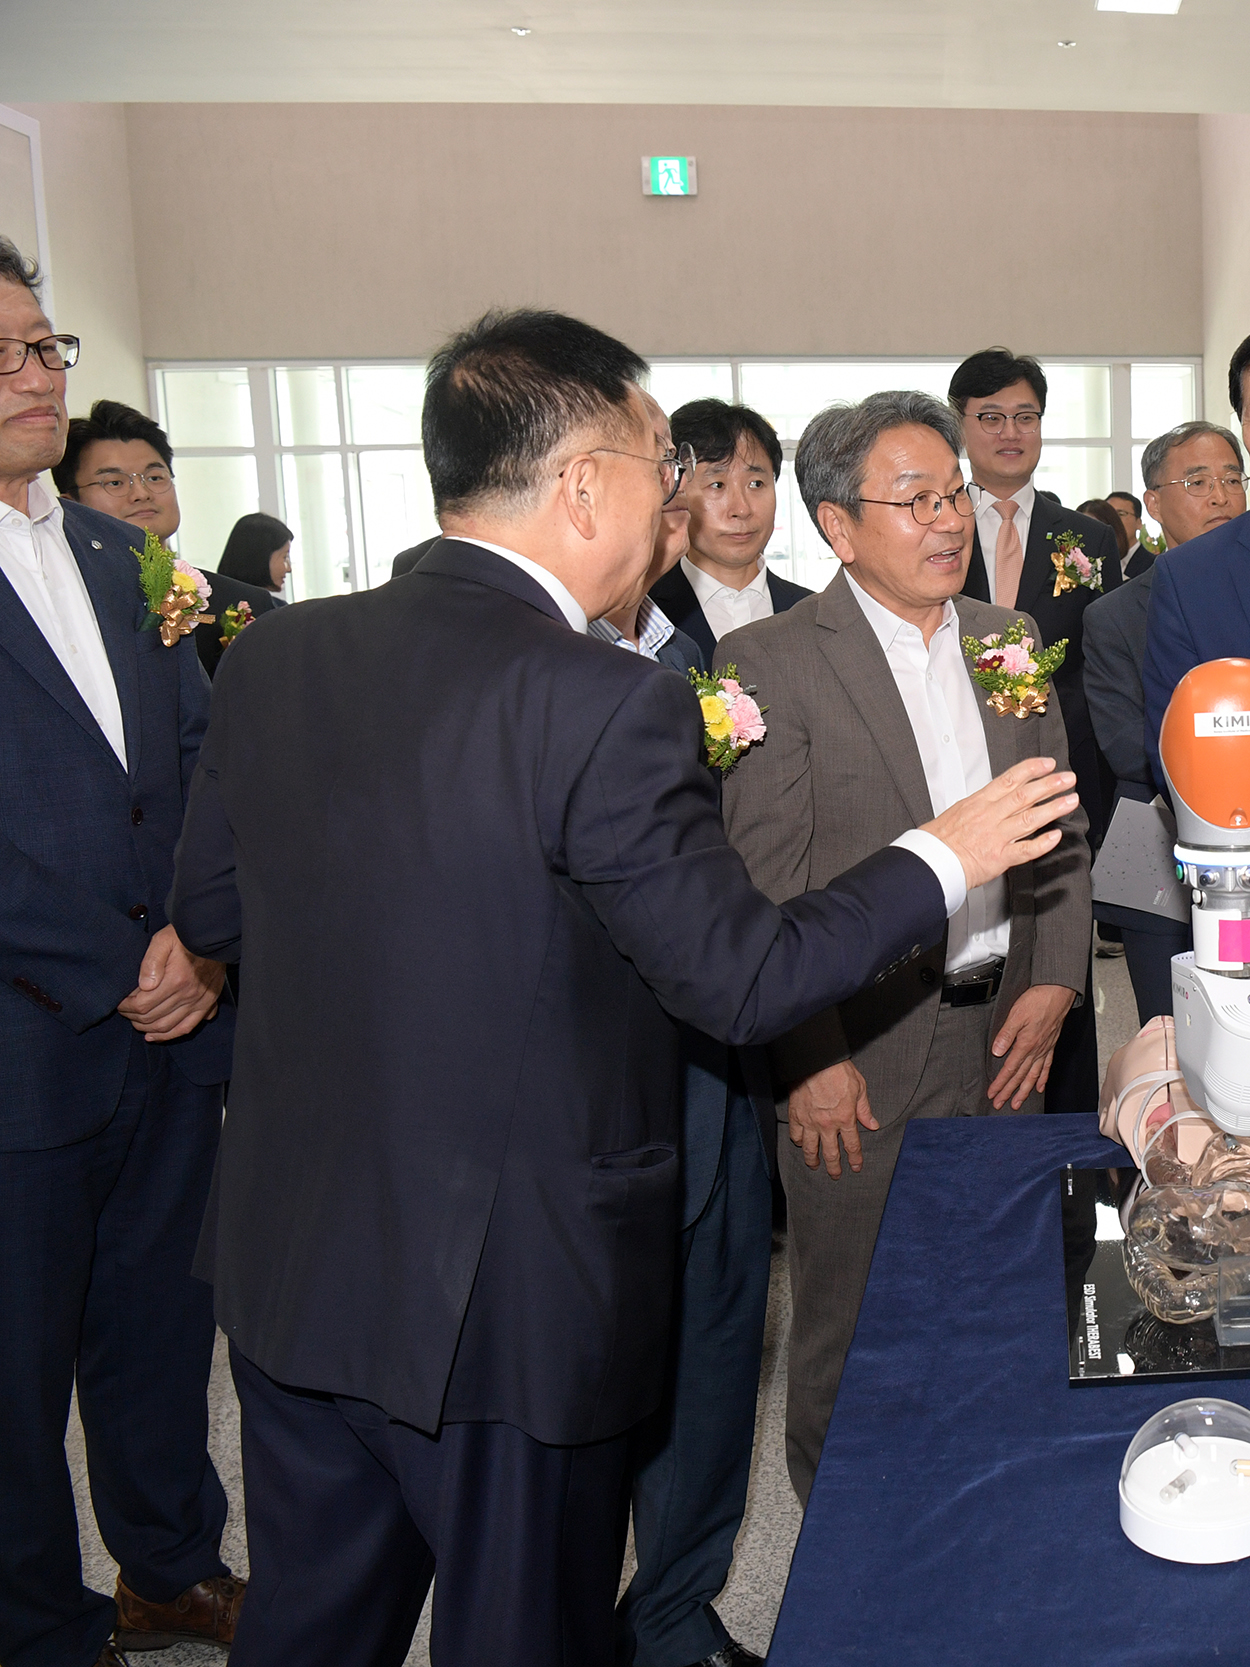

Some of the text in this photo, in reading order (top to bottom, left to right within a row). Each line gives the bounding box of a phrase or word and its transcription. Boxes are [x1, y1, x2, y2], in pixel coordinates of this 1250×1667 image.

[1084, 1284, 1101, 1359] ESD Simulator THERABEST
